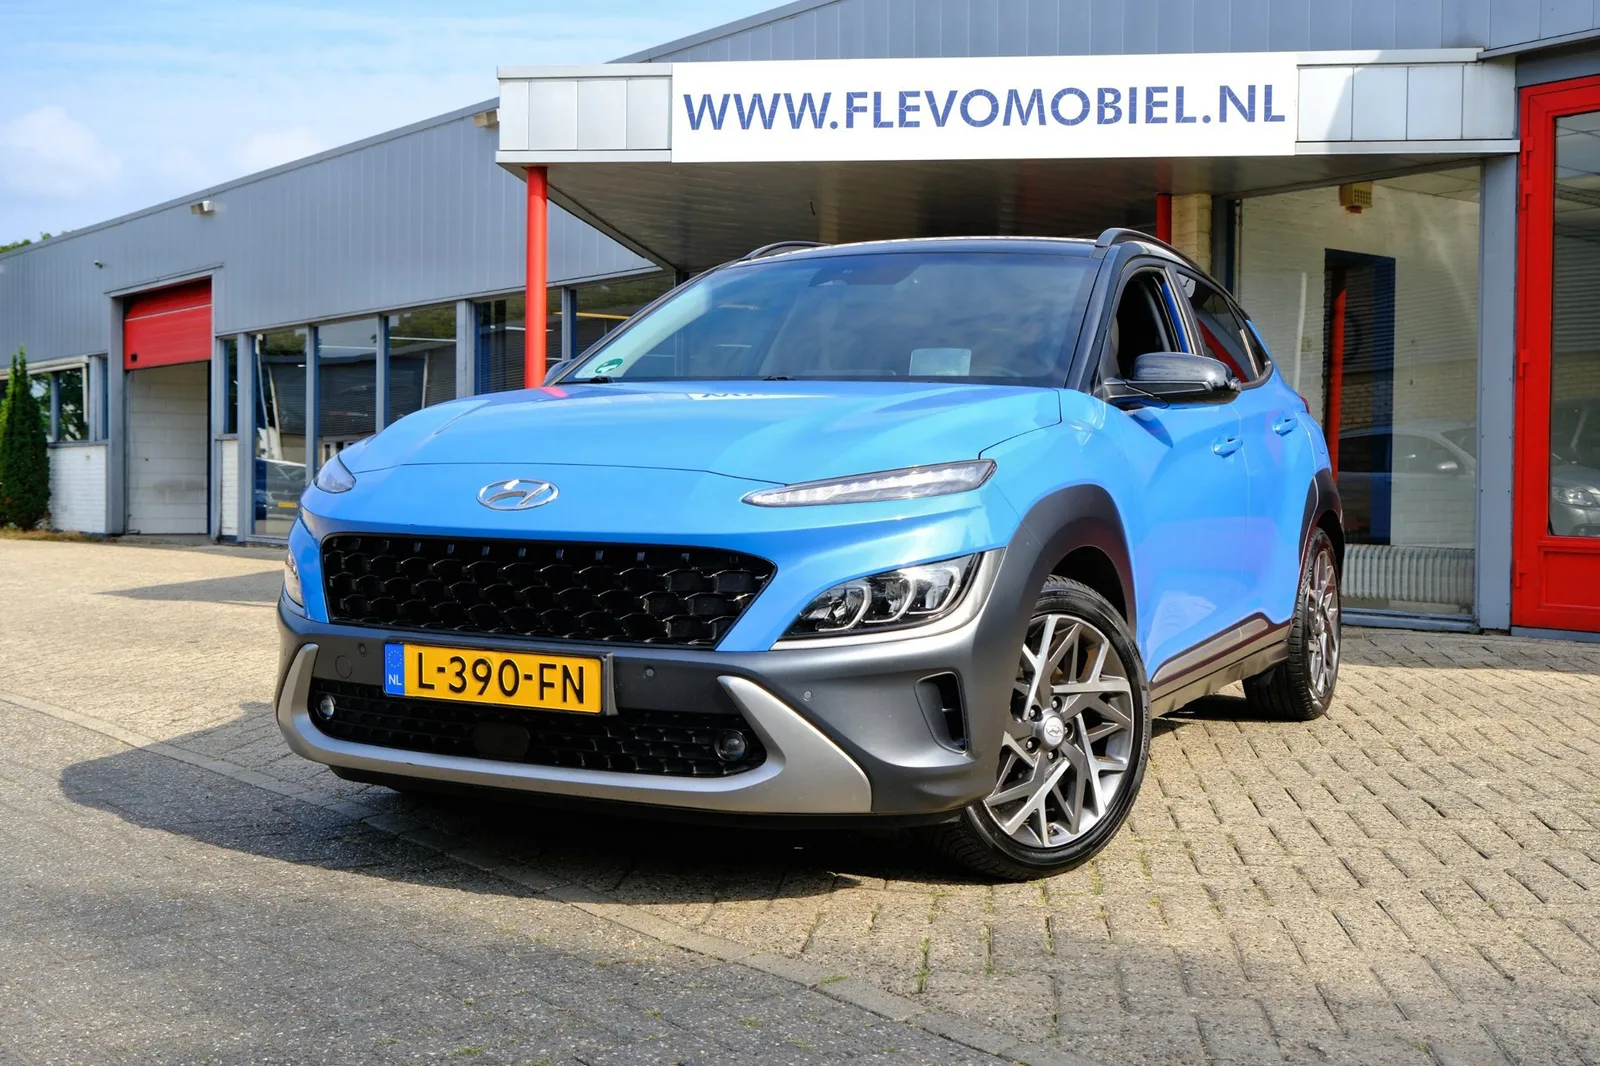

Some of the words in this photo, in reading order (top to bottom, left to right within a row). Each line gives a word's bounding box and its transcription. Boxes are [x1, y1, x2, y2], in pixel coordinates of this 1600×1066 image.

[683, 84, 1286, 131] WWW.FLEVOMOBIEL.NL
[388, 674, 402, 686] NL
[417, 652, 585, 704] L-390-FN
